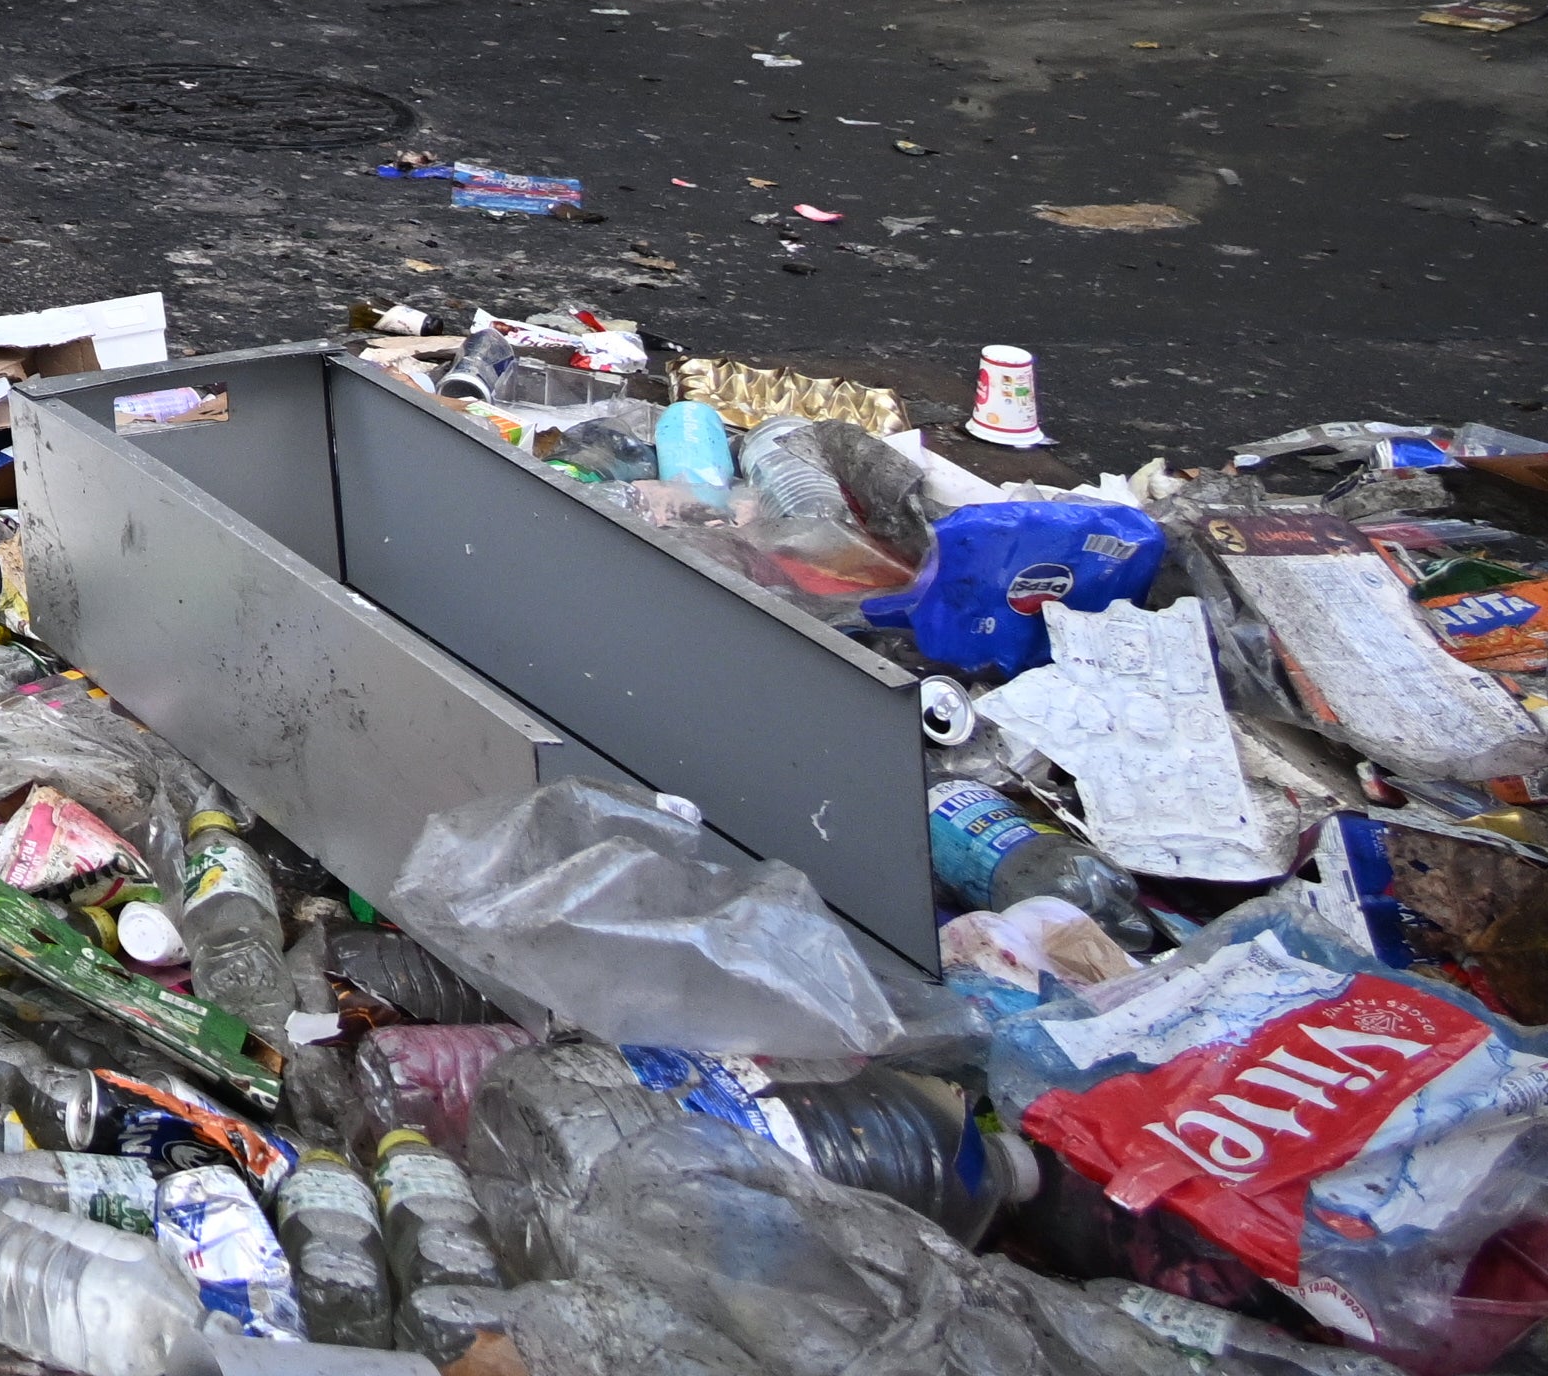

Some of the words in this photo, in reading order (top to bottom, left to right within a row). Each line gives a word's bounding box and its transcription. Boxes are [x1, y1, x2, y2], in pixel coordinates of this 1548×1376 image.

[1009, 579, 1069, 594] PEPSI
[1435, 592, 1537, 627] ANTA
[1142, 1023, 1433, 1183] Vittel
